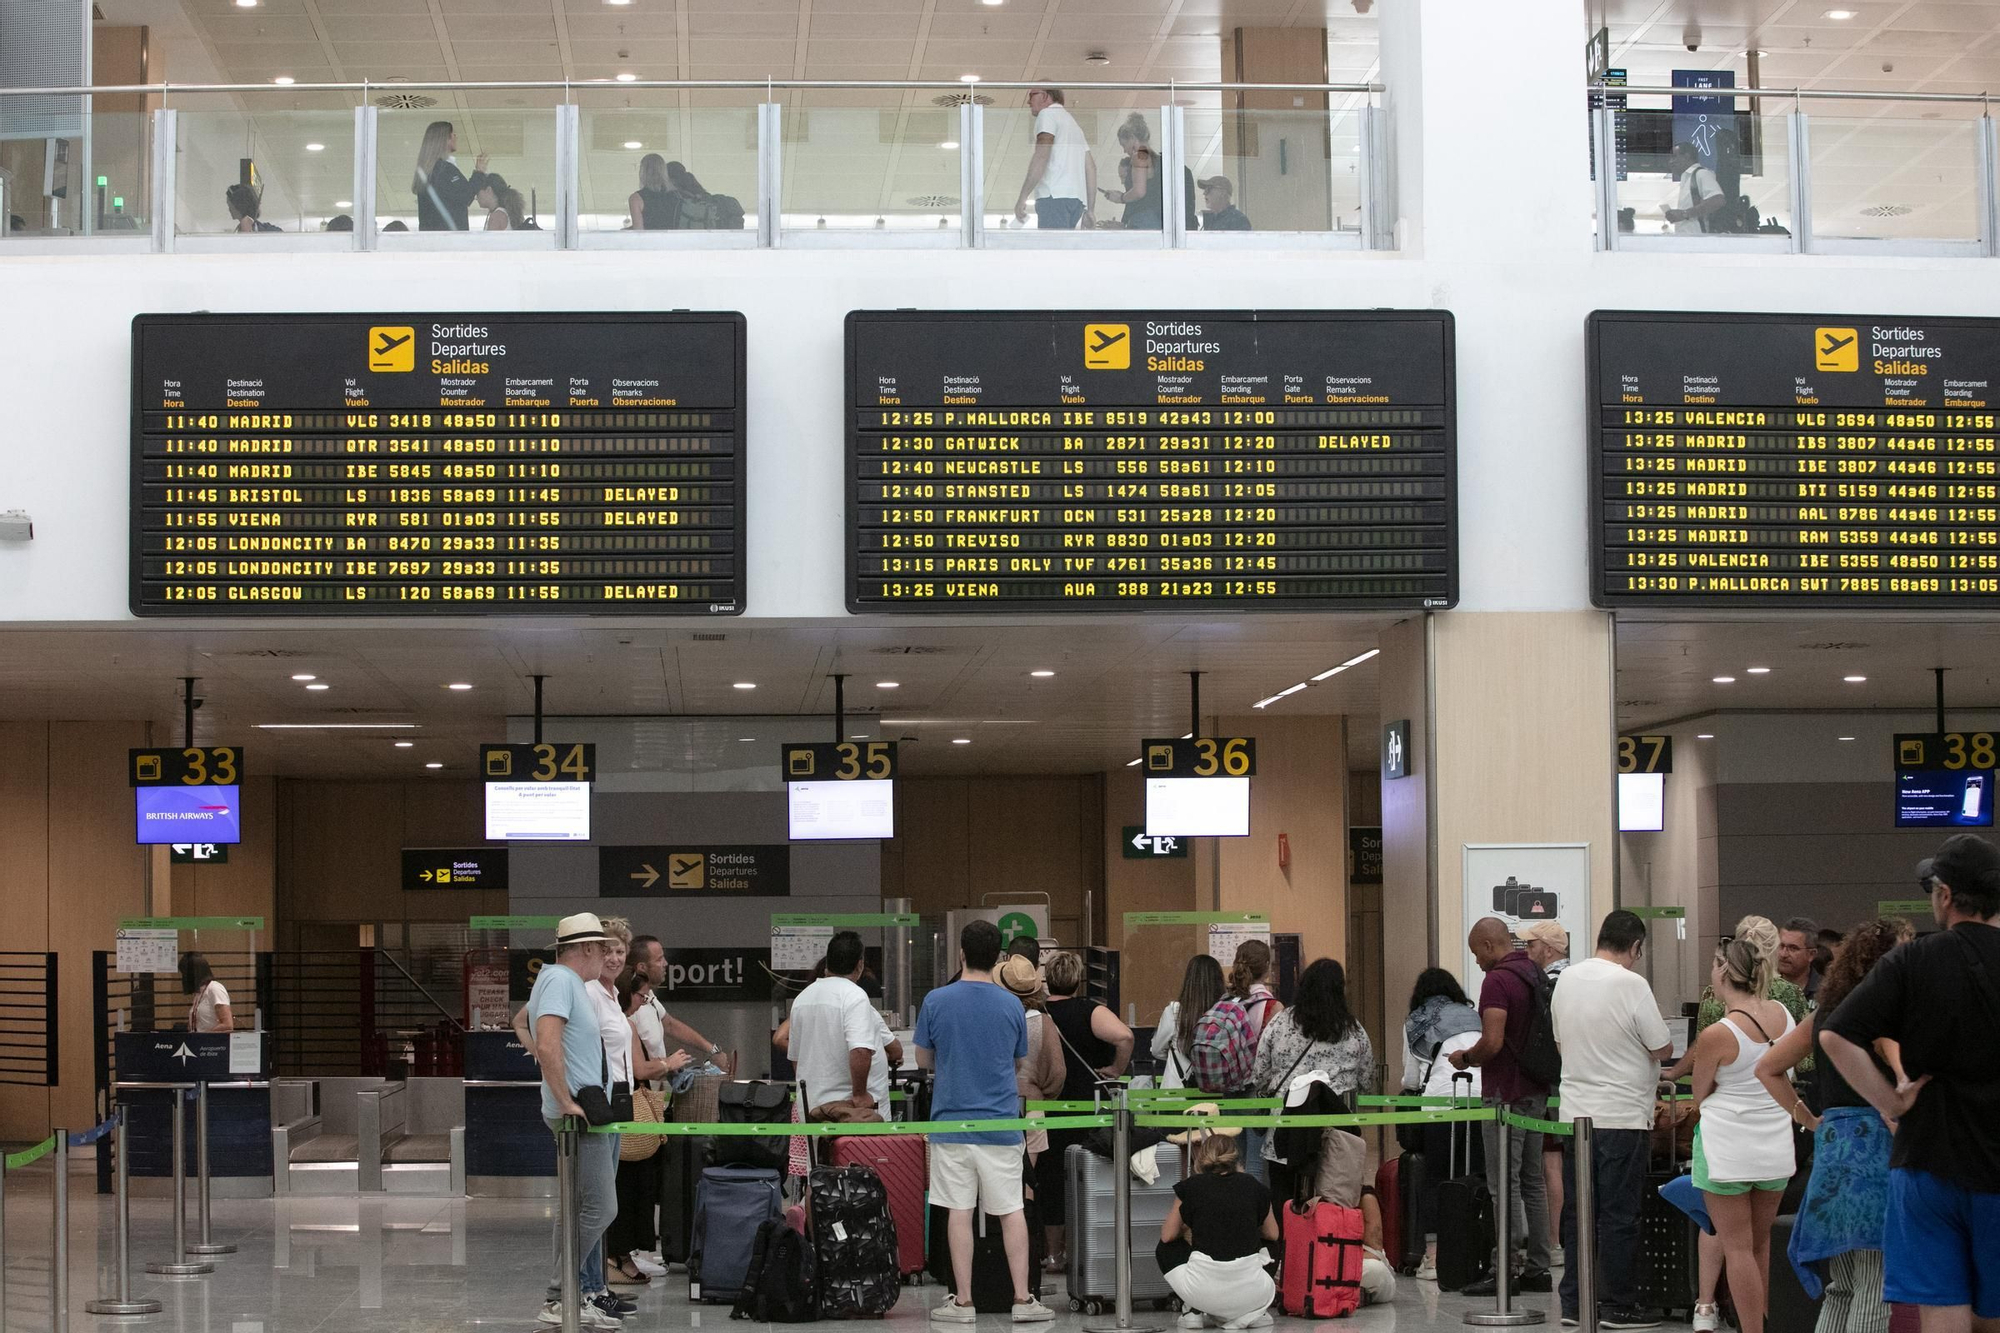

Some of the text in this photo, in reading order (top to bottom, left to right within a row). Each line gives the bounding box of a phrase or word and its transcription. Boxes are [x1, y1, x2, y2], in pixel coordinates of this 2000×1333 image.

[432, 324, 488, 338] Sortides
[1147, 322, 1201, 335] Sortides
[1872, 326, 1924, 340] Sortides
[432, 342, 506, 358] Departures
[1147, 340, 1220, 355] Departures
[1873, 344, 1941, 361] Departures
[432, 359, 489, 374] Salidas
[1148, 356, 1204, 371] Salidas
[1874, 360, 1927, 375] Salidas
[164, 377, 659, 388] Hora Destinació Vol Mostrador Embarcament Porta Observacions
[164, 387, 642, 398] Time Destination Flight Counter Boarding Gate Remarks
[164, 399, 184, 408] Hora
[227, 399, 259, 407] Destino
[441, 398, 485, 406] Mostrador
[506, 398, 550, 407] Embarque
[570, 398, 598, 406] Puerta
[613, 397, 676, 405] Observaciones
[1623, 394, 1985, 408] Hora Destino Vuelo Mostrador Embarque
[168, 414, 560, 428] 11:40 MADRID VLG 3418 48a50 11:10
[882, 412, 1274, 424] 12:25 P.MALLORCA IBE 8519 42a43 12:00
[1626, 412, 1994, 428] 13:25 VALENCIA VLG 3694 48a50 12:55
[882, 436, 1390, 450] 12:30 GATWICK BA 2871 29a31 12:20 DELAYED
[166, 488, 678, 502] 11:45 BRISTOL LS 1836 58a69 11:45 DELAYED
[1626, 482, 1996, 498] 13:25 MADRID BTI 5159 44a46 12:55
[166, 536, 560, 550] 12:05 LONDONCITY BA 8470 29a33 11:35
[882, 556, 1276, 572] 13:15 PARIS ORLY TVF 4761 35a36 12:45
[1628, 576, 1998, 592] 13:30 P.MALLORCA SWT 7885 68a69 13:05
[166, 586, 678, 600] 12:05 GLASGOW LS 120 58a69 11:55 DELAYED
[1194, 738, 1249, 776] 36
[1619, 736, 1665, 773] 37
[1943, 733, 1996, 770] 38
[182, 748, 236, 785] 33
[532, 744, 589, 781] 34
[835, 742, 892, 780] 35
[710, 854, 754, 864] Sortides
[710, 866, 757, 877] Departures
[710, 879, 749, 889] Salidas
